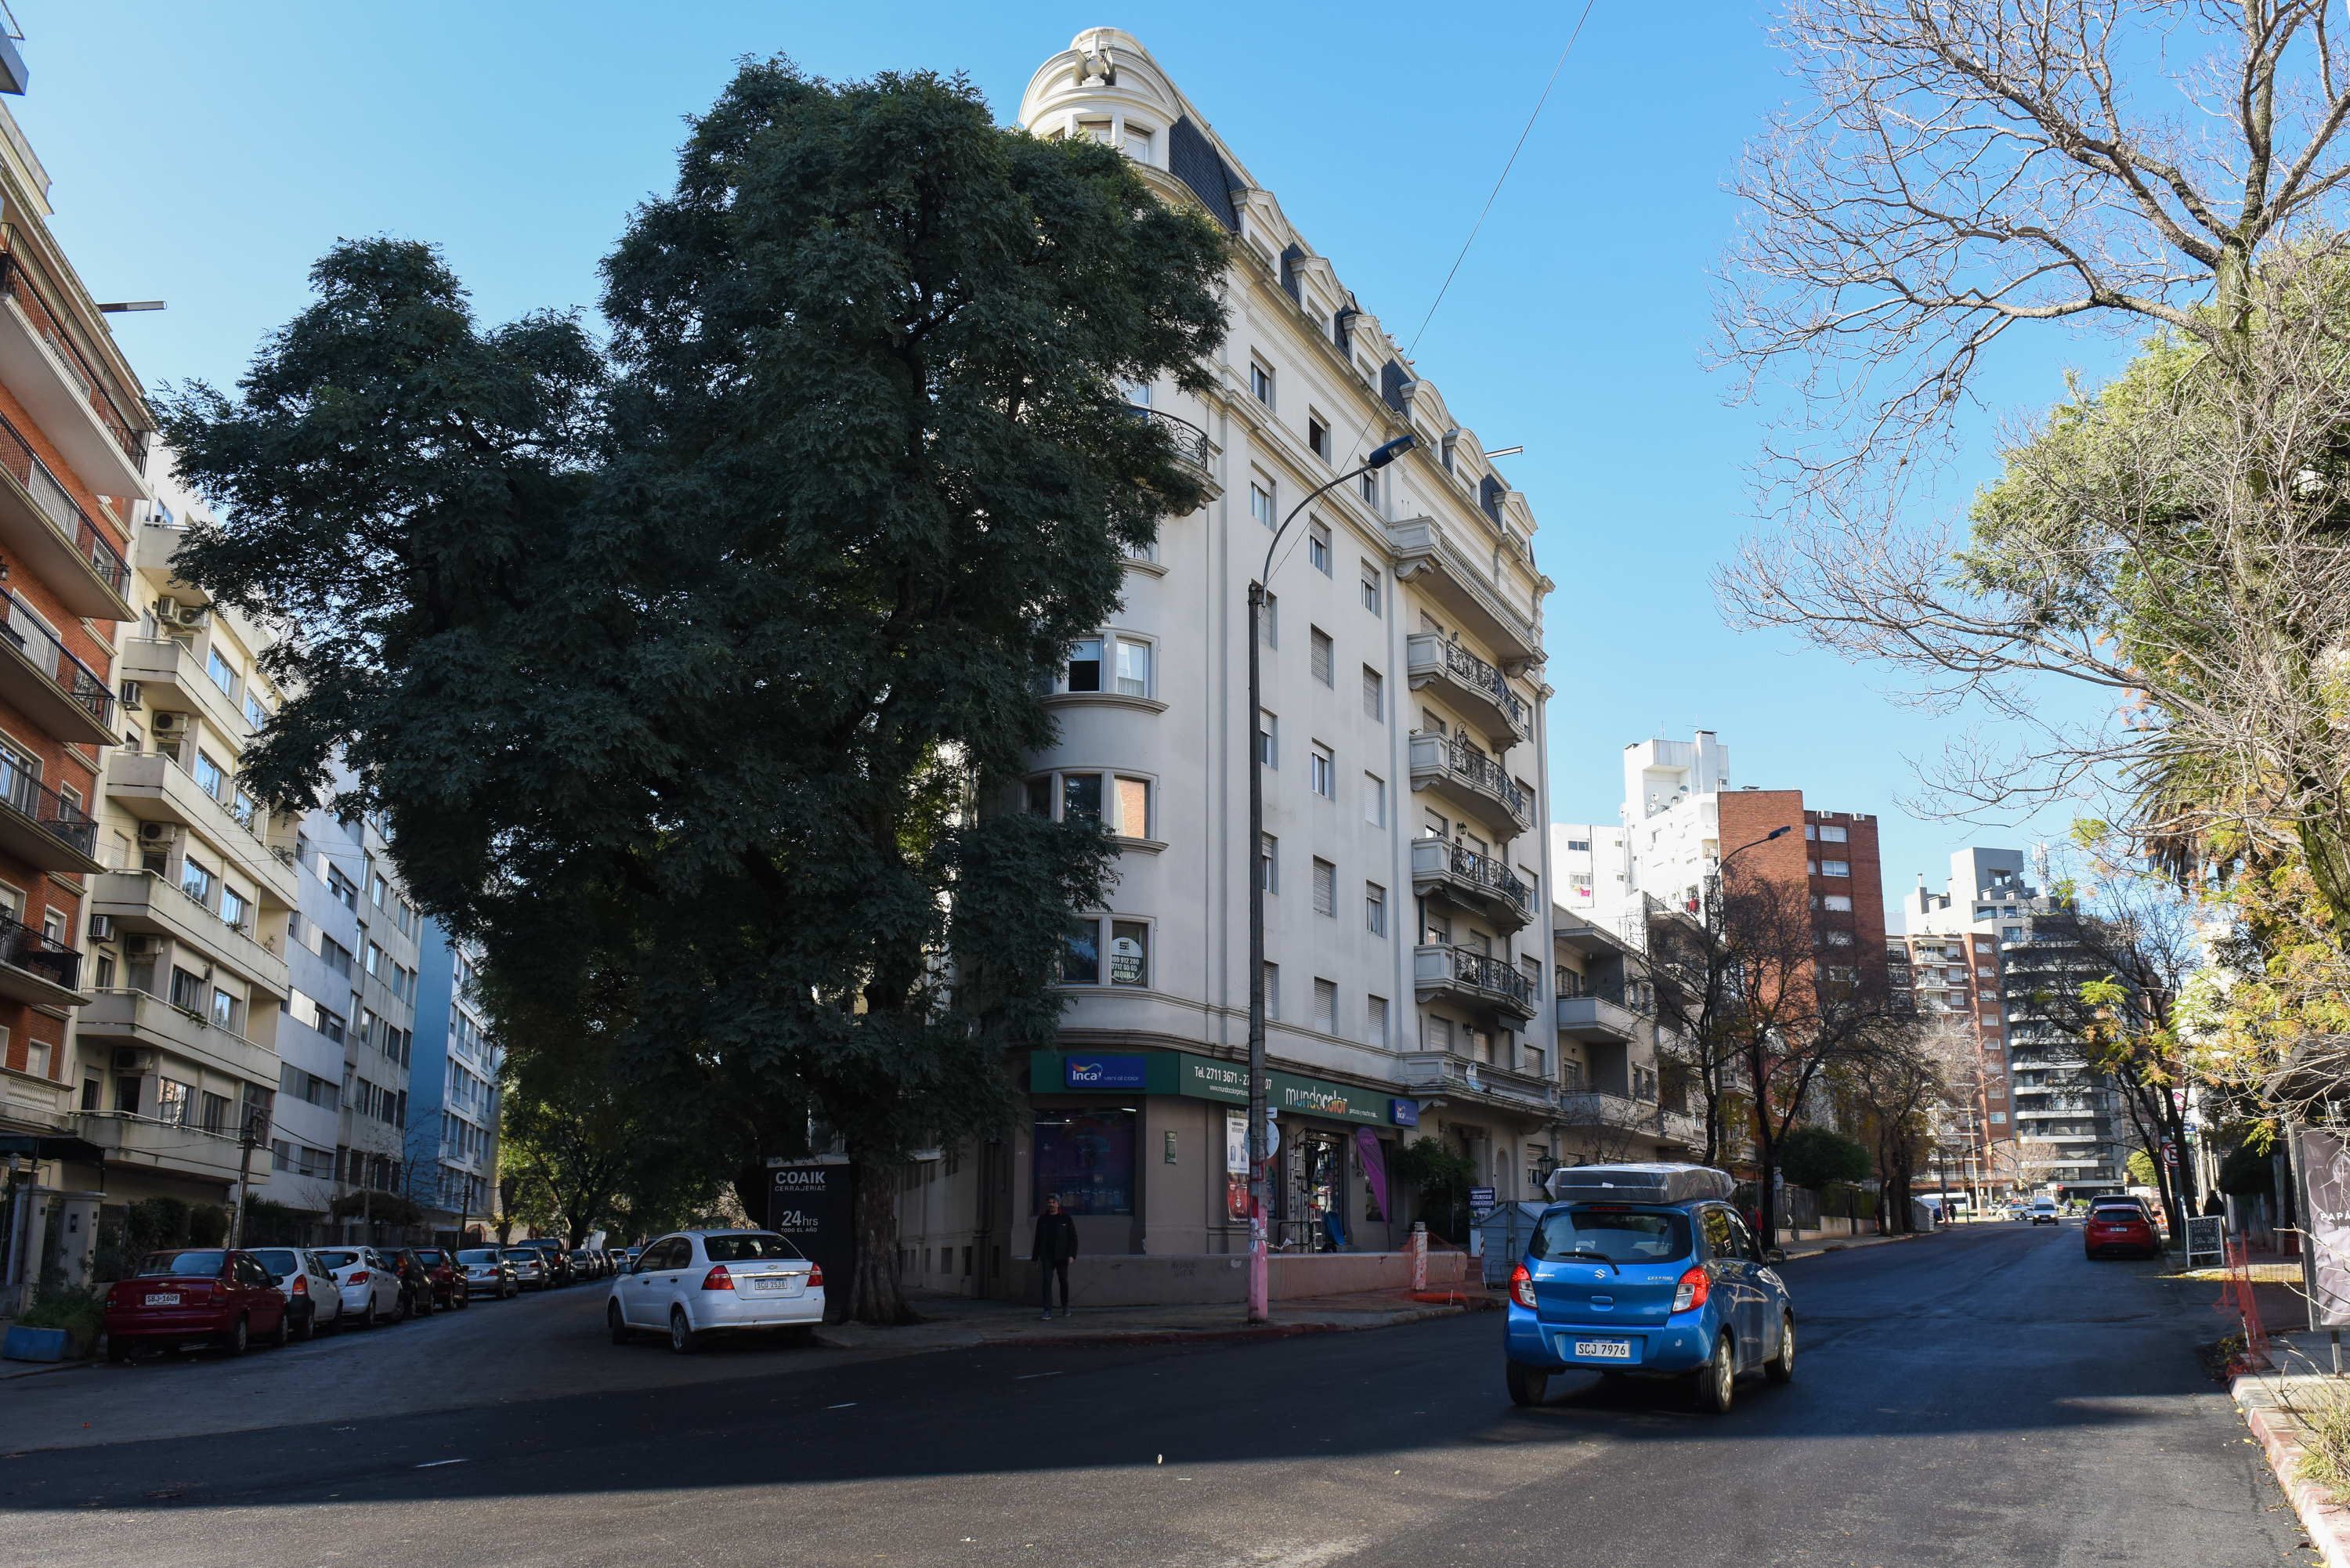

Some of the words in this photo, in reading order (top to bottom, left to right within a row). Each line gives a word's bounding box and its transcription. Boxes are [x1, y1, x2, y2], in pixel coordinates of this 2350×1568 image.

[1113, 970, 1135, 979] ALQUILA
[1072, 1070, 1097, 1081] Inca
[1194, 1066, 1205, 1078] Tel.
[1206, 1068, 1221, 1081] 2711
[1223, 1070, 1238, 1084] 3671
[1209, 1084, 1250, 1097] www.mundocolorpinturas
[1285, 1086, 1348, 1115] mundocolor
[1349, 1107, 1360, 1115] pinturas
[775, 1171, 826, 1184] COAIK
[1578, 1343, 1597, 1354] SCJ
[1601, 1344, 1626, 1356] 7976
